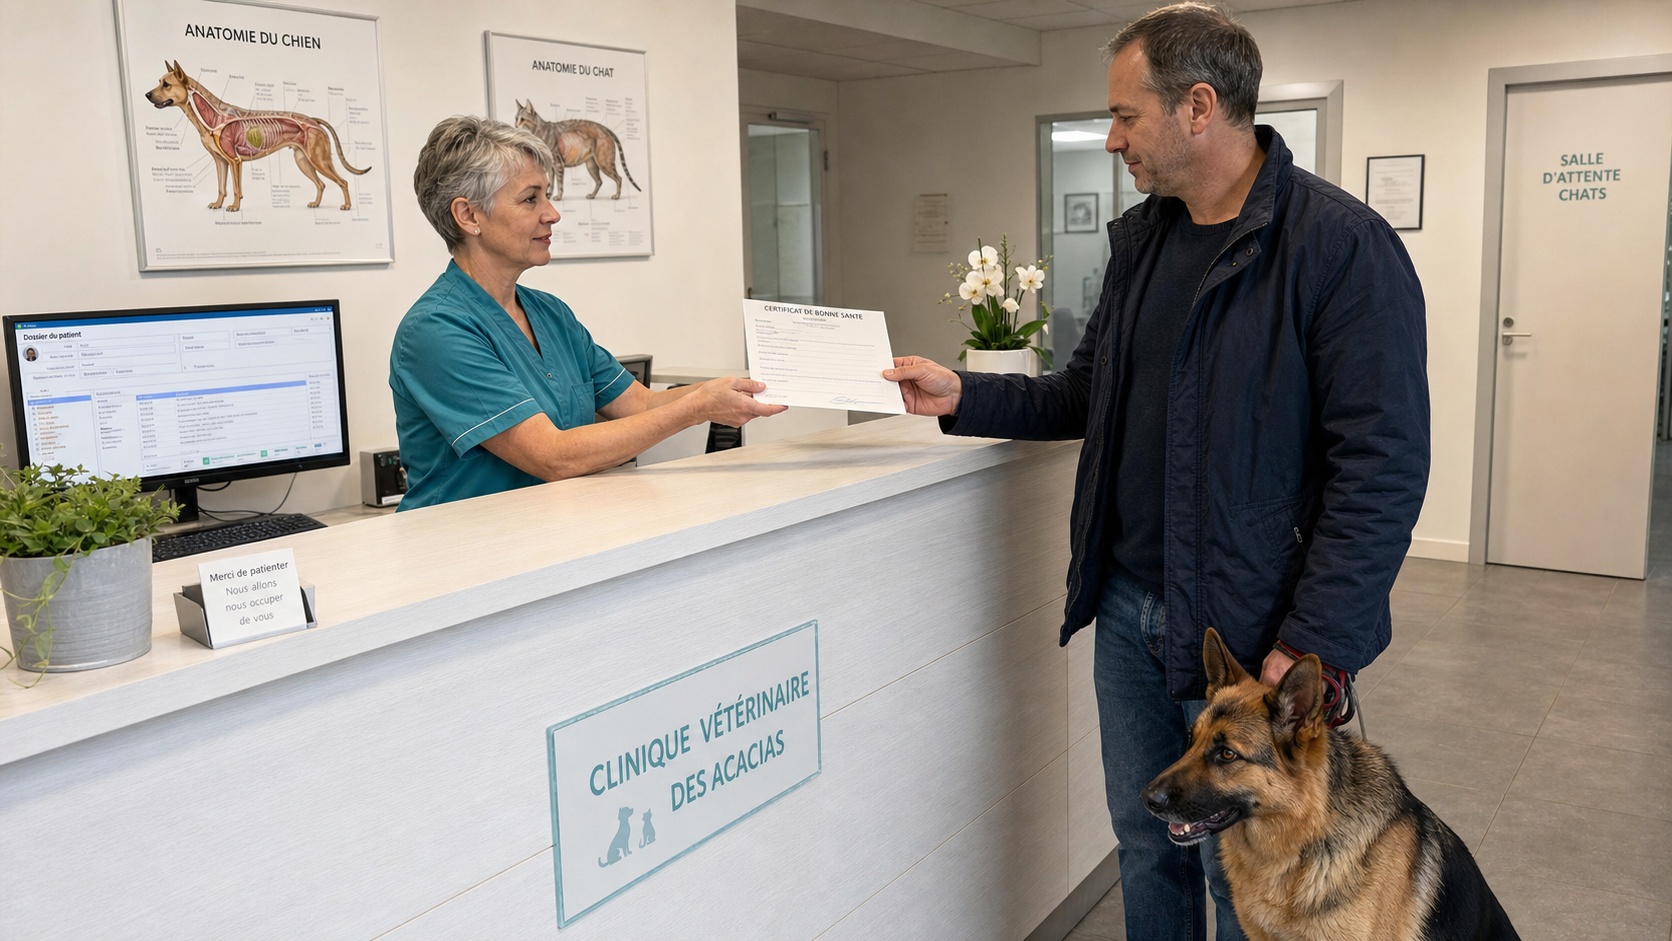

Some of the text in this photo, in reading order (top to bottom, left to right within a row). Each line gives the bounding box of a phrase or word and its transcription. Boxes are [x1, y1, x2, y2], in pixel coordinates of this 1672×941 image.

[185, 24, 321, 49] ANATOMIE DU CHIEN
[532, 60, 614, 78] ANATOMIE DU CHAT
[1560, 152, 1604, 167] SALLE
[1543, 169, 1621, 184] D'ATTENTE
[1559, 187, 1607, 201] CHATS
[764, 305, 802, 315] CERTIFICAT
[815, 310, 839, 318] BONNE
[23, 333, 48, 341] Dossier
[59, 331, 82, 340] patient
[209, 561, 289, 582] Merci de patienter
[226, 579, 277, 596] Nous allons
[225, 594, 284, 612] nous occuper
[239, 611, 274, 625] de vous
[589, 670, 810, 796] CLINIQUE VÉTÉRINAIRE
[671, 729, 785, 812] DES ACACIAS
